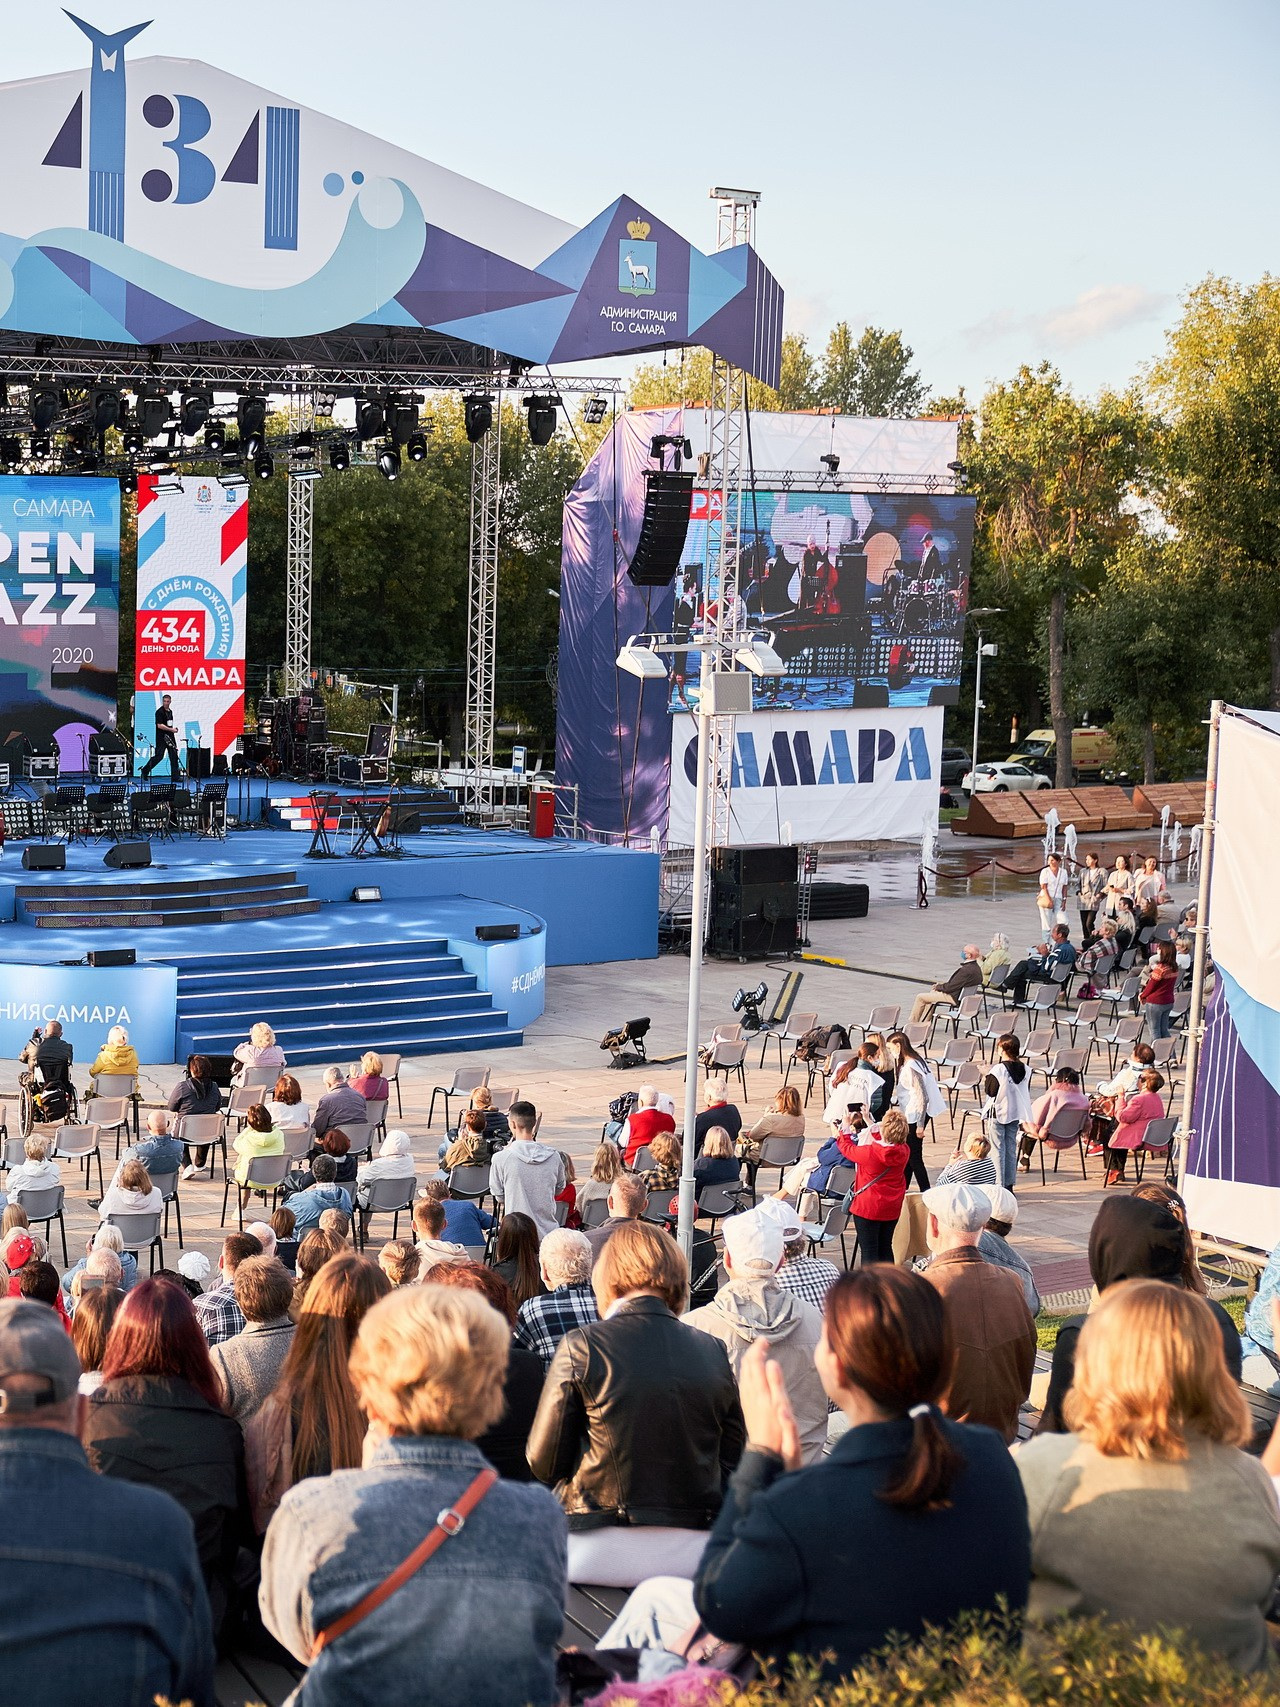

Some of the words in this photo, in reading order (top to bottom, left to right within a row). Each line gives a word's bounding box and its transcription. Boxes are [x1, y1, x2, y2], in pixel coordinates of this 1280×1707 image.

[41, 8, 300, 251] 434
[599, 306, 677, 323] АДМИНИСТРАЦИЯ
[611, 321, 626, 333] Г.О.
[628, 322, 666, 335] САМАРА
[12, 498, 95, 517] САМАРА
[147, 599, 157, 609] С
[156, 578, 192, 602] ДНЁМ
[194, 582, 231, 658] РОЖДЕНИЯ!
[140, 617, 201, 644] 434
[52, 647, 94, 664] 2020
[140, 645, 164, 653] ДЕНЬ
[166, 645, 200, 653] ГОРОДА
[139, 667, 242, 687] САМАРА
